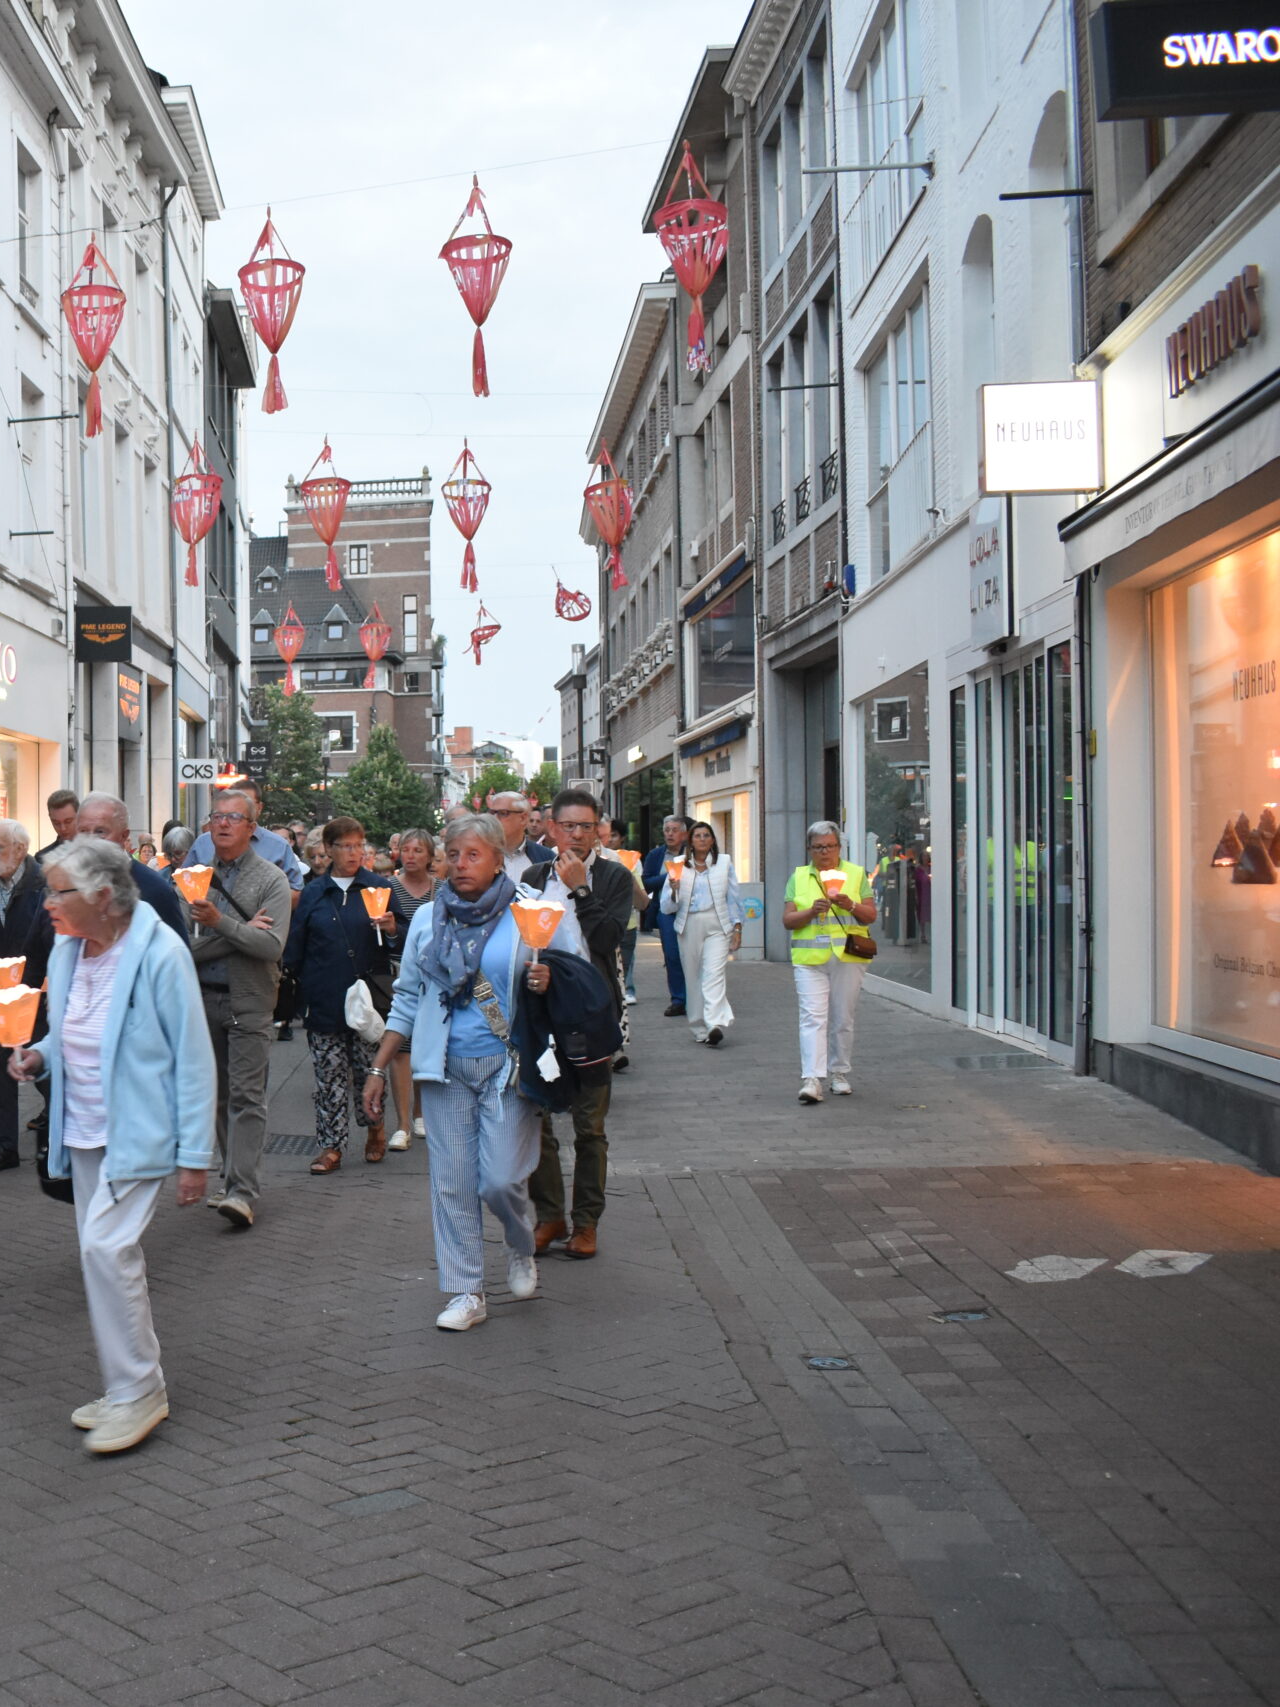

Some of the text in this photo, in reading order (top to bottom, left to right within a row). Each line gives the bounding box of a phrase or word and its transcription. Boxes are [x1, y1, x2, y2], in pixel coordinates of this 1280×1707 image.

[1163, 27, 1280, 68] SWARO
[1166, 264, 1261, 399] NEUHAUS
[996, 418, 1086, 443] NEUHAUS
[1232, 659, 1276, 702] NEUHAUS
[181, 764, 213, 779] CKS
